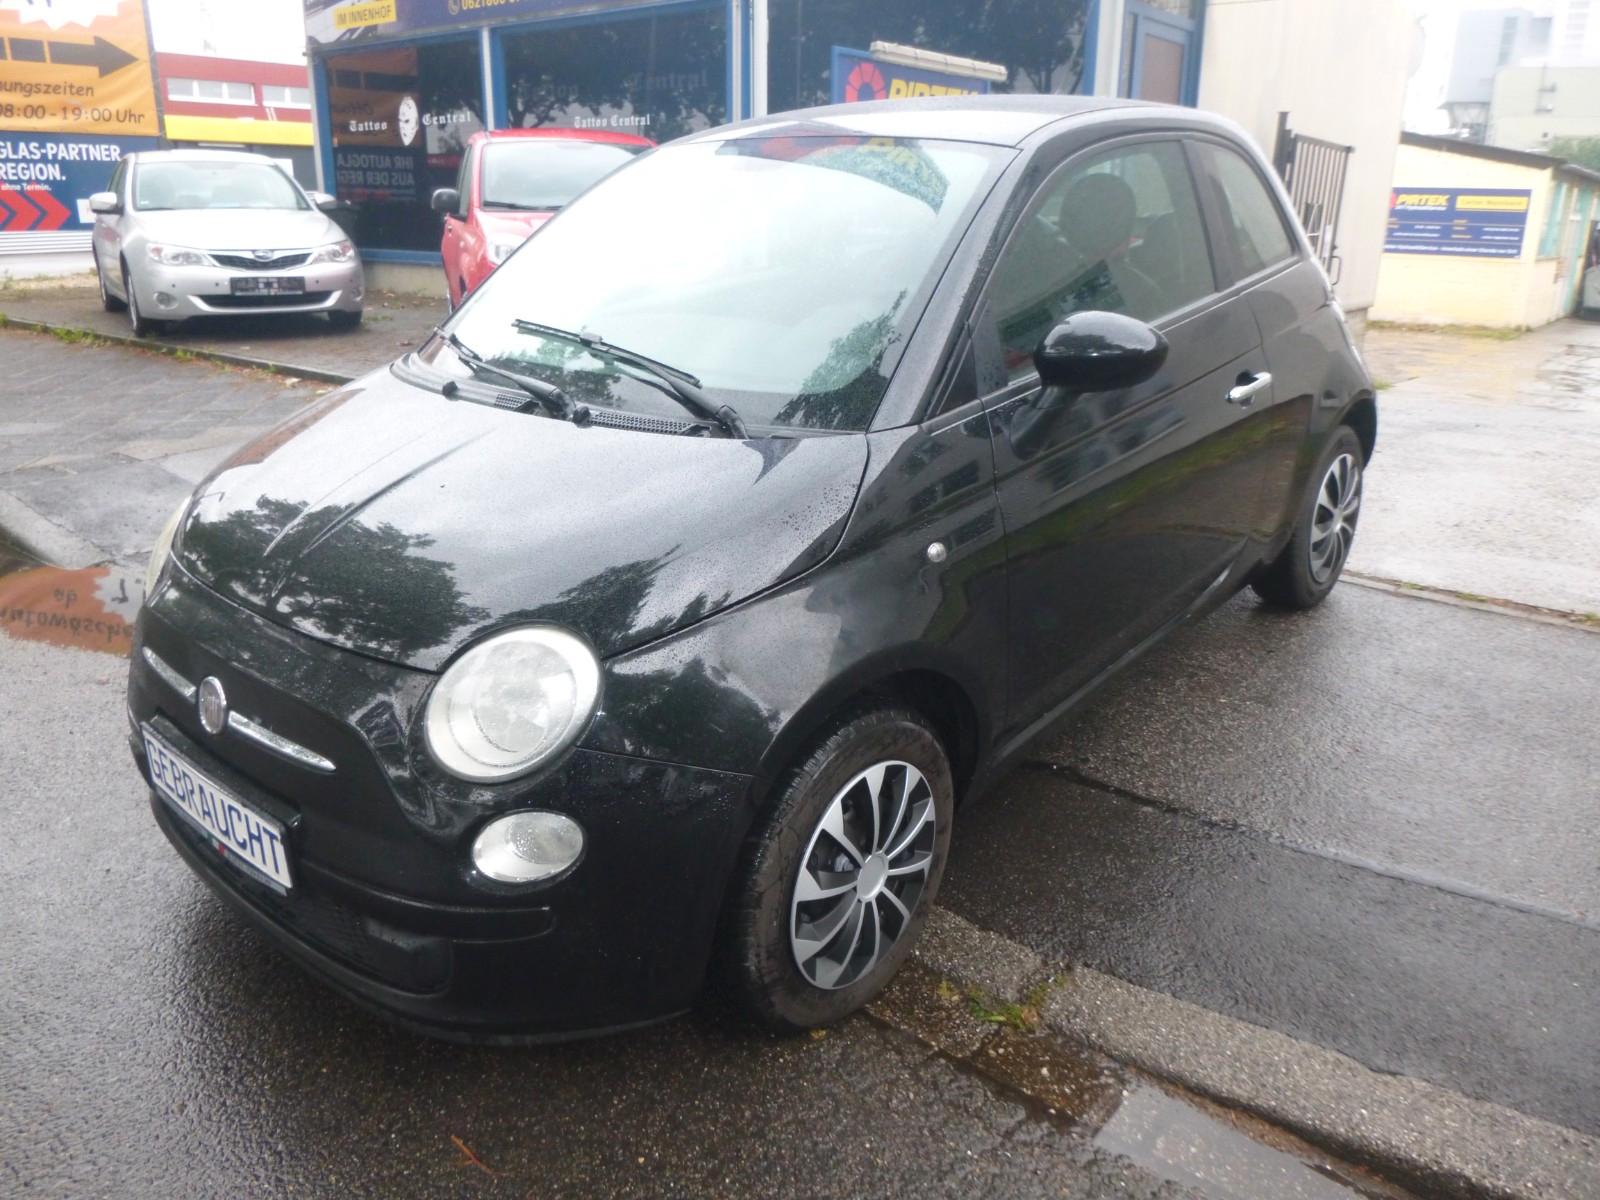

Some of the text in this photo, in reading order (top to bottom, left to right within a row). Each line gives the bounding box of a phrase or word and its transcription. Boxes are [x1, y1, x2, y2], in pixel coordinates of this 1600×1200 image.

[349, 5, 392, 23] INNENHOF
[0, 80, 95, 97] ungszeiten
[62, 106, 112, 122] 19:00
[116, 110, 145, 123] Uhr
[349, 111, 472, 132] Tattoo Central
[574, 114, 651, 129] Tattoo Central
[0, 141, 121, 161] GLAS-PARTNER
[0, 162, 66, 181] REGION.
[148, 741, 281, 874] GEBRAUCHT
